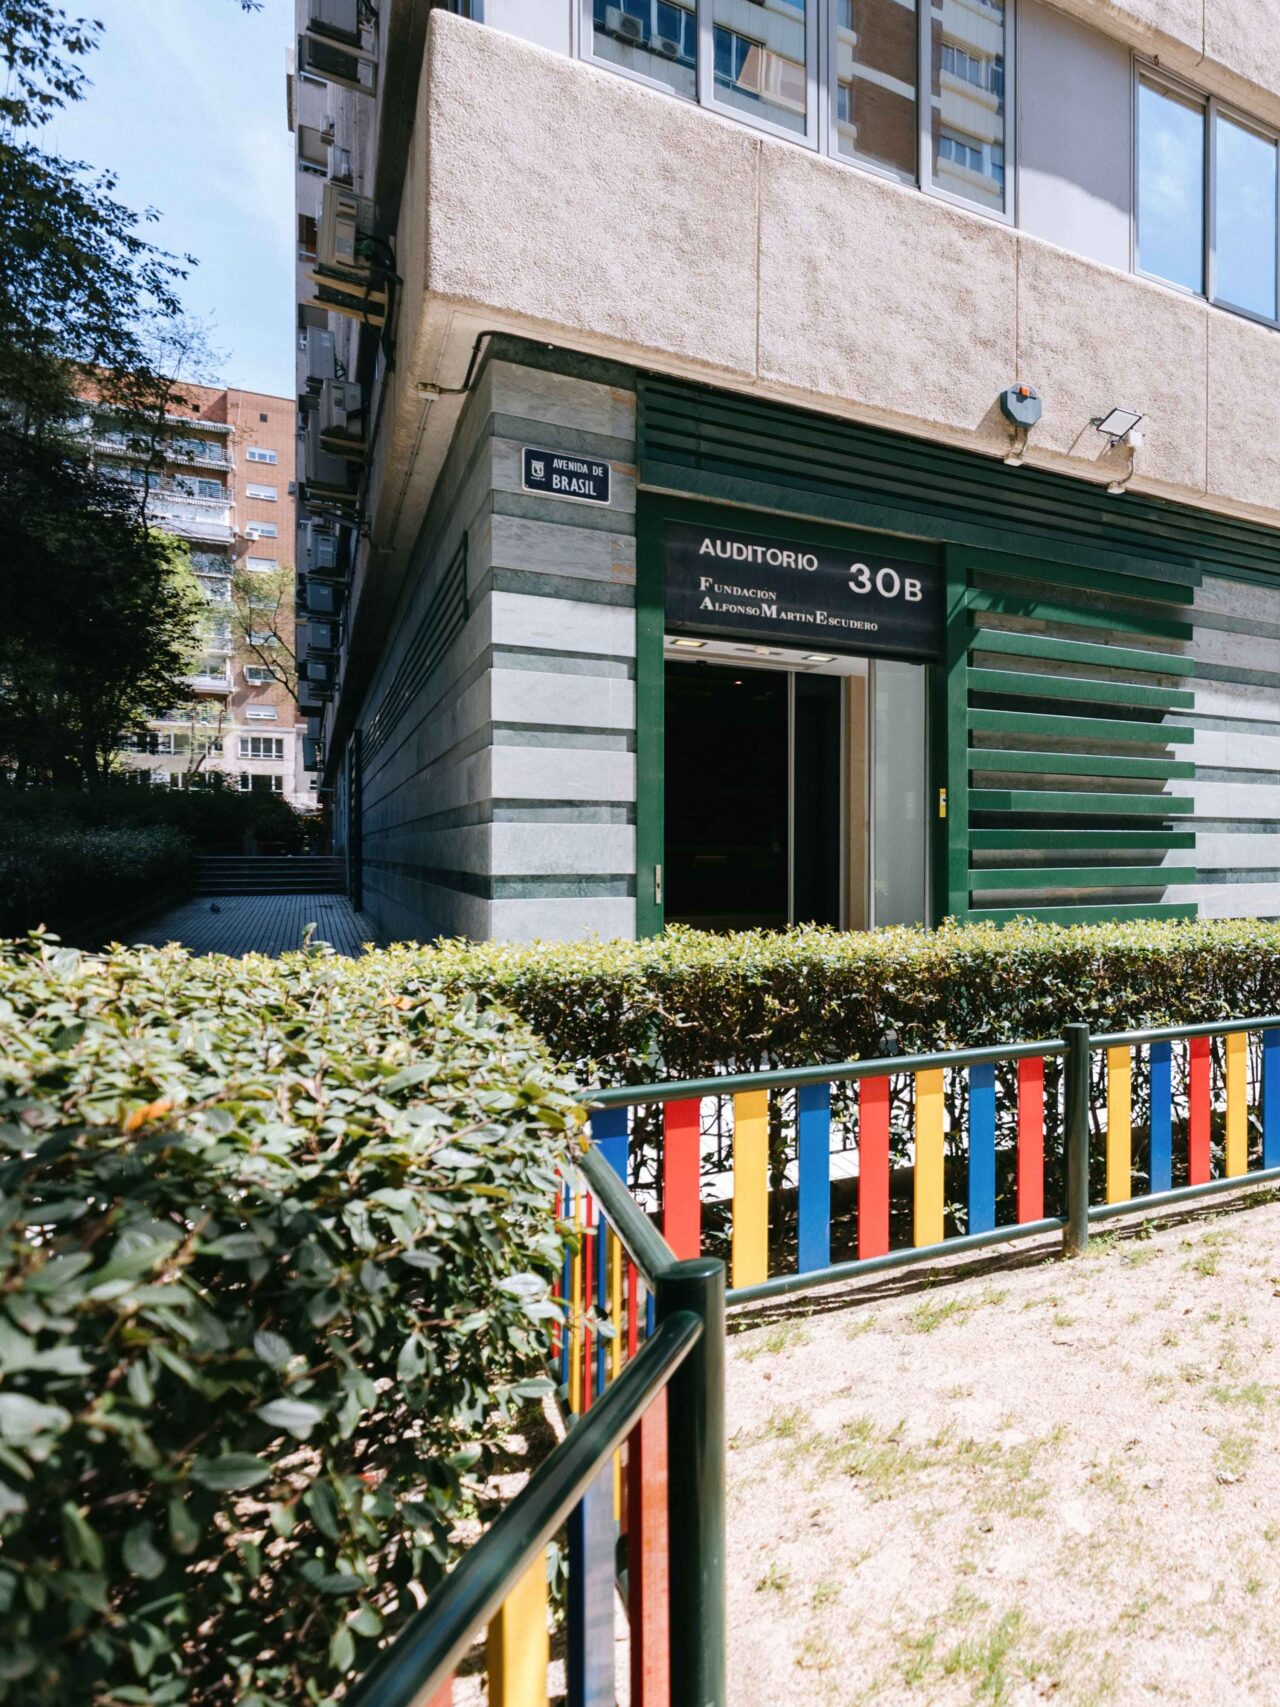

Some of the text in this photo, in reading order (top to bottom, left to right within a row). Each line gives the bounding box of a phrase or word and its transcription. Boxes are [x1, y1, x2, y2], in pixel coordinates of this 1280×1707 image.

[552, 474, 597, 495] BRASIL
[553, 458, 604, 477] AVENIDA DE
[699, 537, 819, 572] AUDITORIO
[848, 562, 923, 602] 30B
[699, 596, 760, 616] ALFONSO
[815, 610, 879, 632] ESCUDERO
